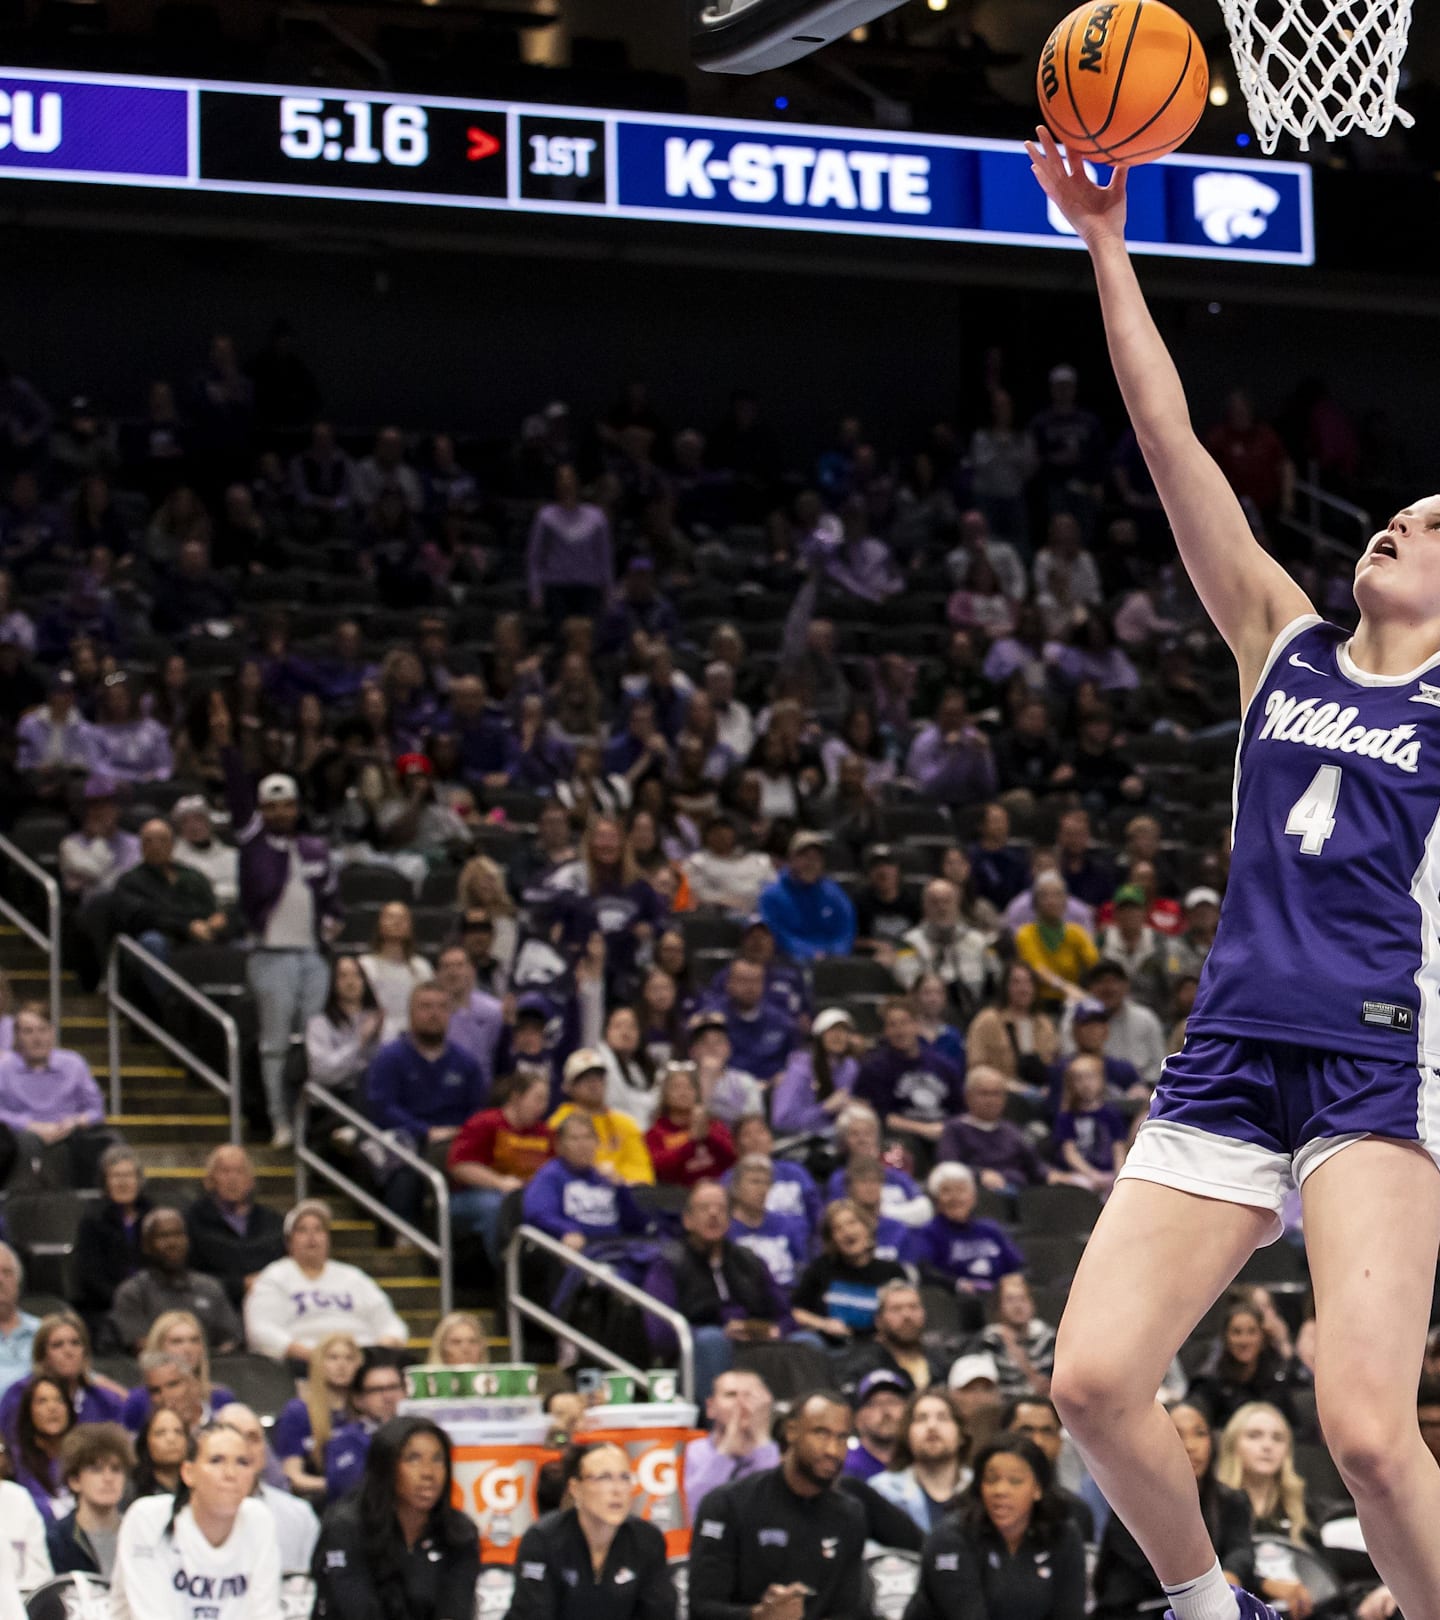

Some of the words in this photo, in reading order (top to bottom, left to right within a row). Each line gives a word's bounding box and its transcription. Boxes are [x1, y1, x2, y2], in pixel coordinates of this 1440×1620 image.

[1079, 3, 1120, 74] NCAA
[0, 88, 62, 154] U
[279, 96, 428, 167] 5:16
[528, 133, 597, 178] 1ST
[664, 136, 932, 215] K-STATE
[1258, 689, 1423, 774] Wildcats
[1284, 763, 1343, 856] 4
[1398, 1012, 1408, 1025] M
